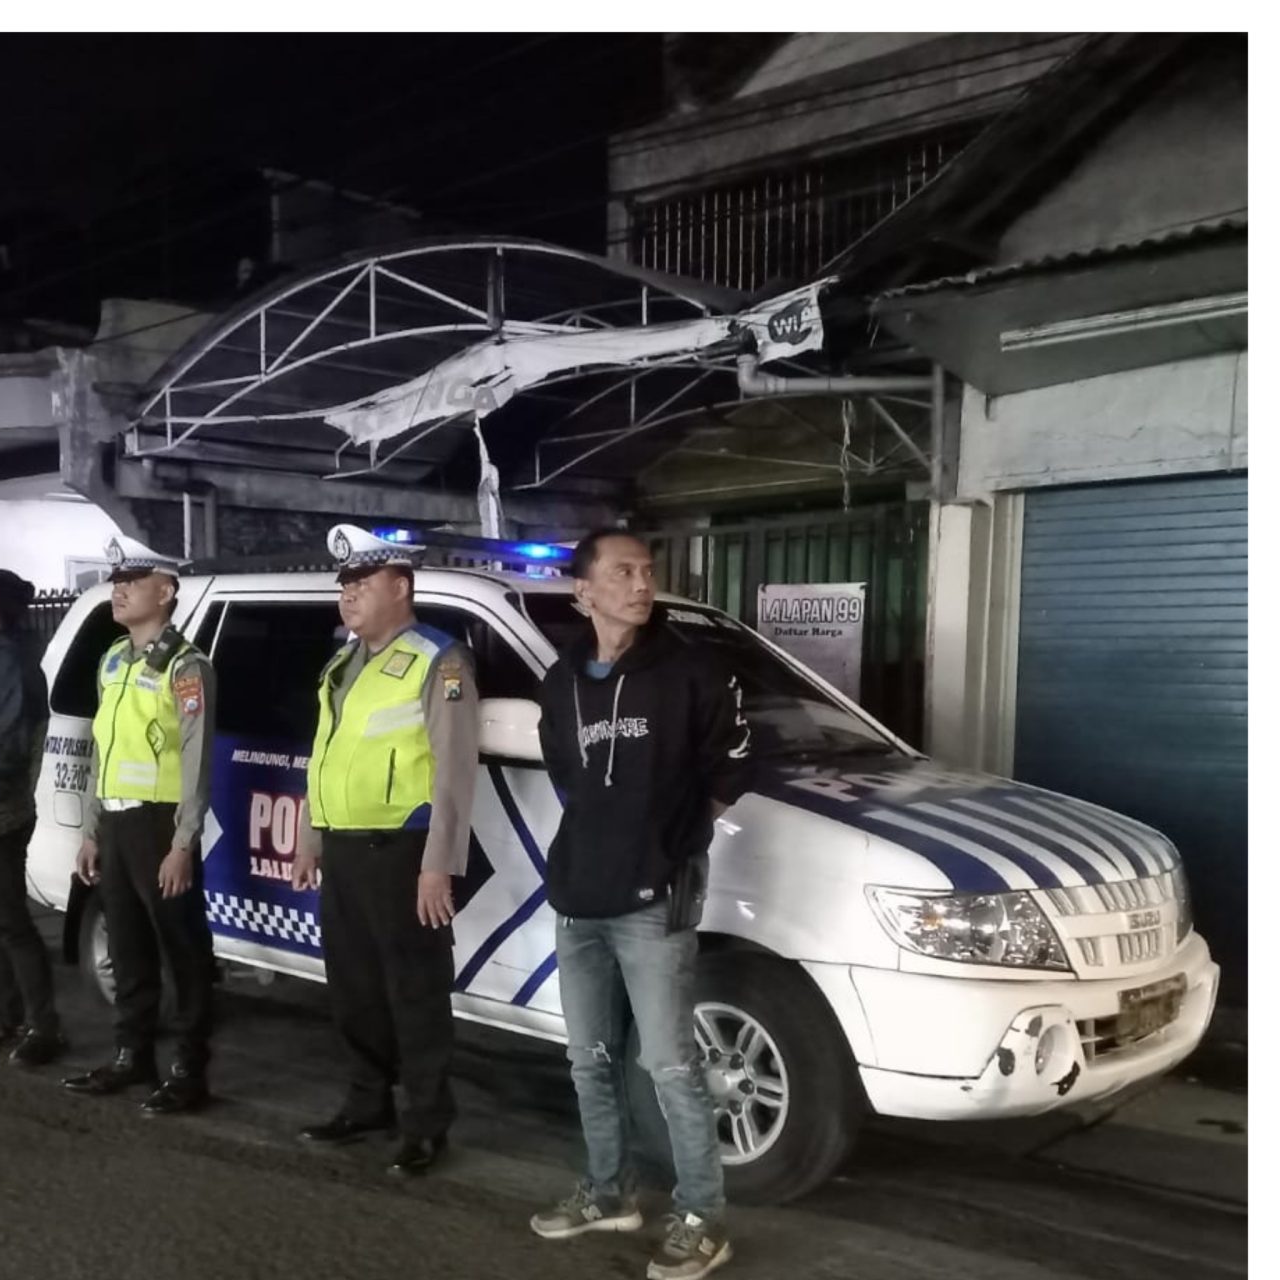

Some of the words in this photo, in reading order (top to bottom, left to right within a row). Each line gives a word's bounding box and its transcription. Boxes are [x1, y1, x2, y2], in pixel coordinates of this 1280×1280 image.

[762, 597, 834, 624] LALAPAN
[836, 596, 861, 623] 99
[774, 627, 810, 636] Daftar
[812, 627, 843, 637] Harga
[232, 749, 290, 770] MELINDUNGI,
